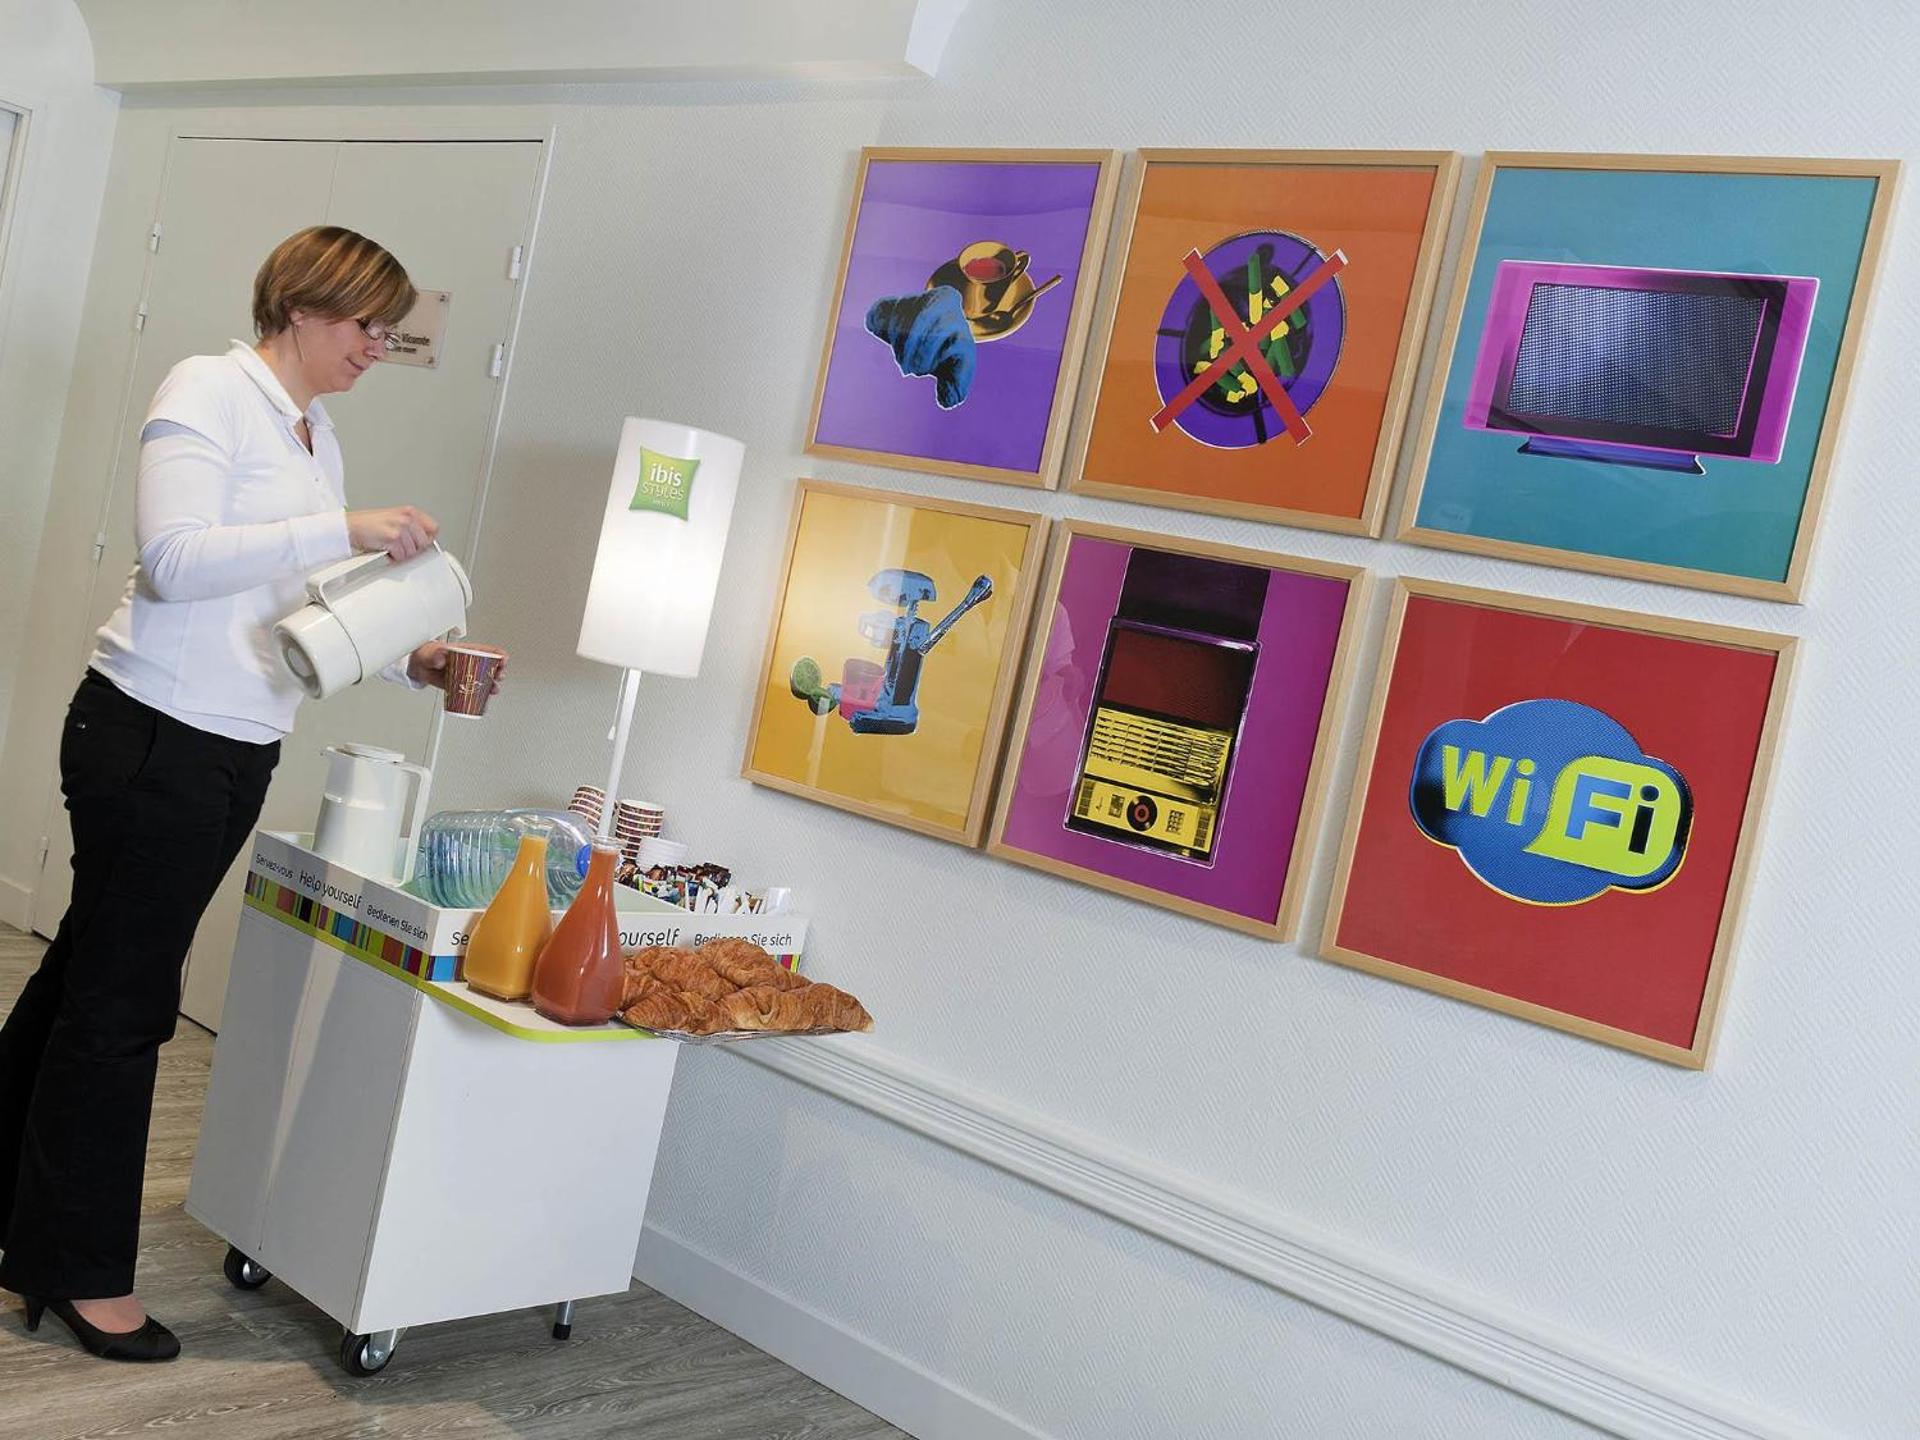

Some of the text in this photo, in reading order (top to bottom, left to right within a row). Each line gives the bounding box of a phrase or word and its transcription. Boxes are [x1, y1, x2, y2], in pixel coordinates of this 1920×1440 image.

[650, 463, 682, 487] ibis
[1442, 745, 1660, 855] Wi Fi
[299, 870, 321, 893] Help
[321, 882, 362, 909] yourself
[367, 905, 400, 928] Bedienen
[412, 927, 428, 942] sich
[619, 928, 680, 946] ourself
[751, 933, 768, 946] Sie
[770, 933, 792, 946] sich
